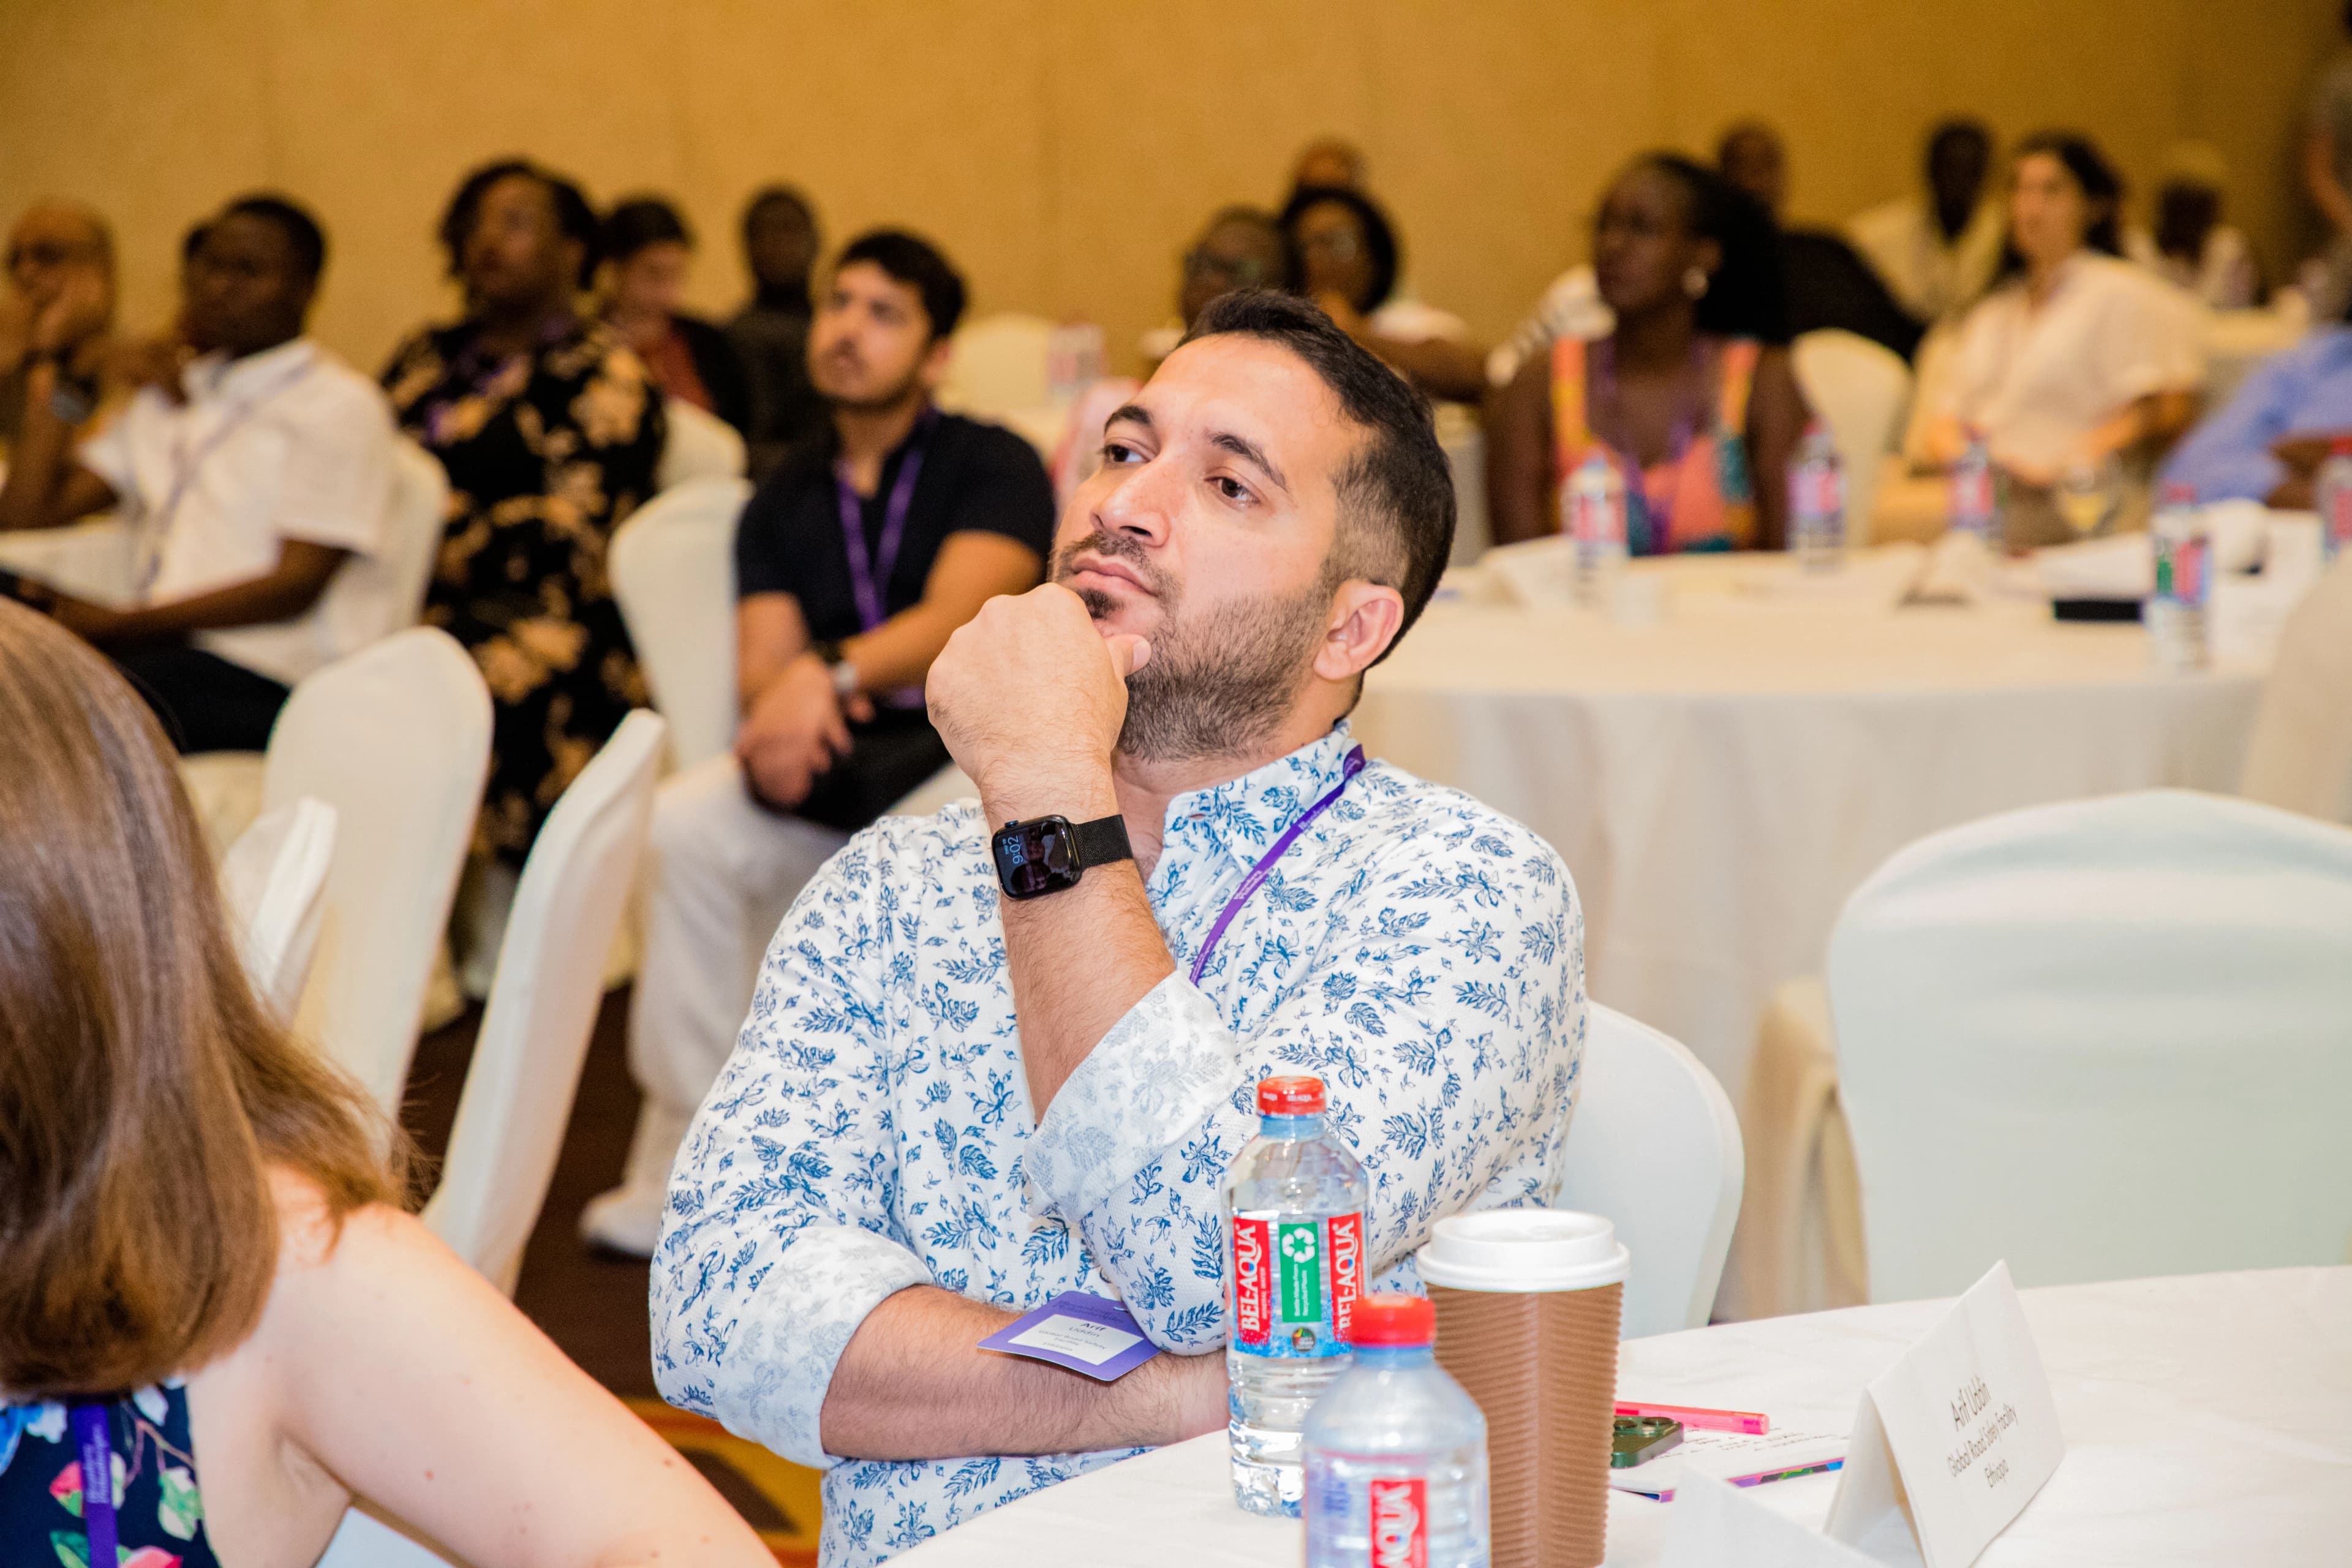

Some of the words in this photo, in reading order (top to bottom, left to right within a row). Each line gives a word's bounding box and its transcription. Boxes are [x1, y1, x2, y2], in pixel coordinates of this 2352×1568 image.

[1008, 835, 1023, 864] 9:02
[1069, 1327, 1100, 1337] Uddin
[1950, 1387, 1971, 1432] Arif
[1948, 1442, 1971, 1477] Global
[1968, 1428, 1987, 1460] Road
